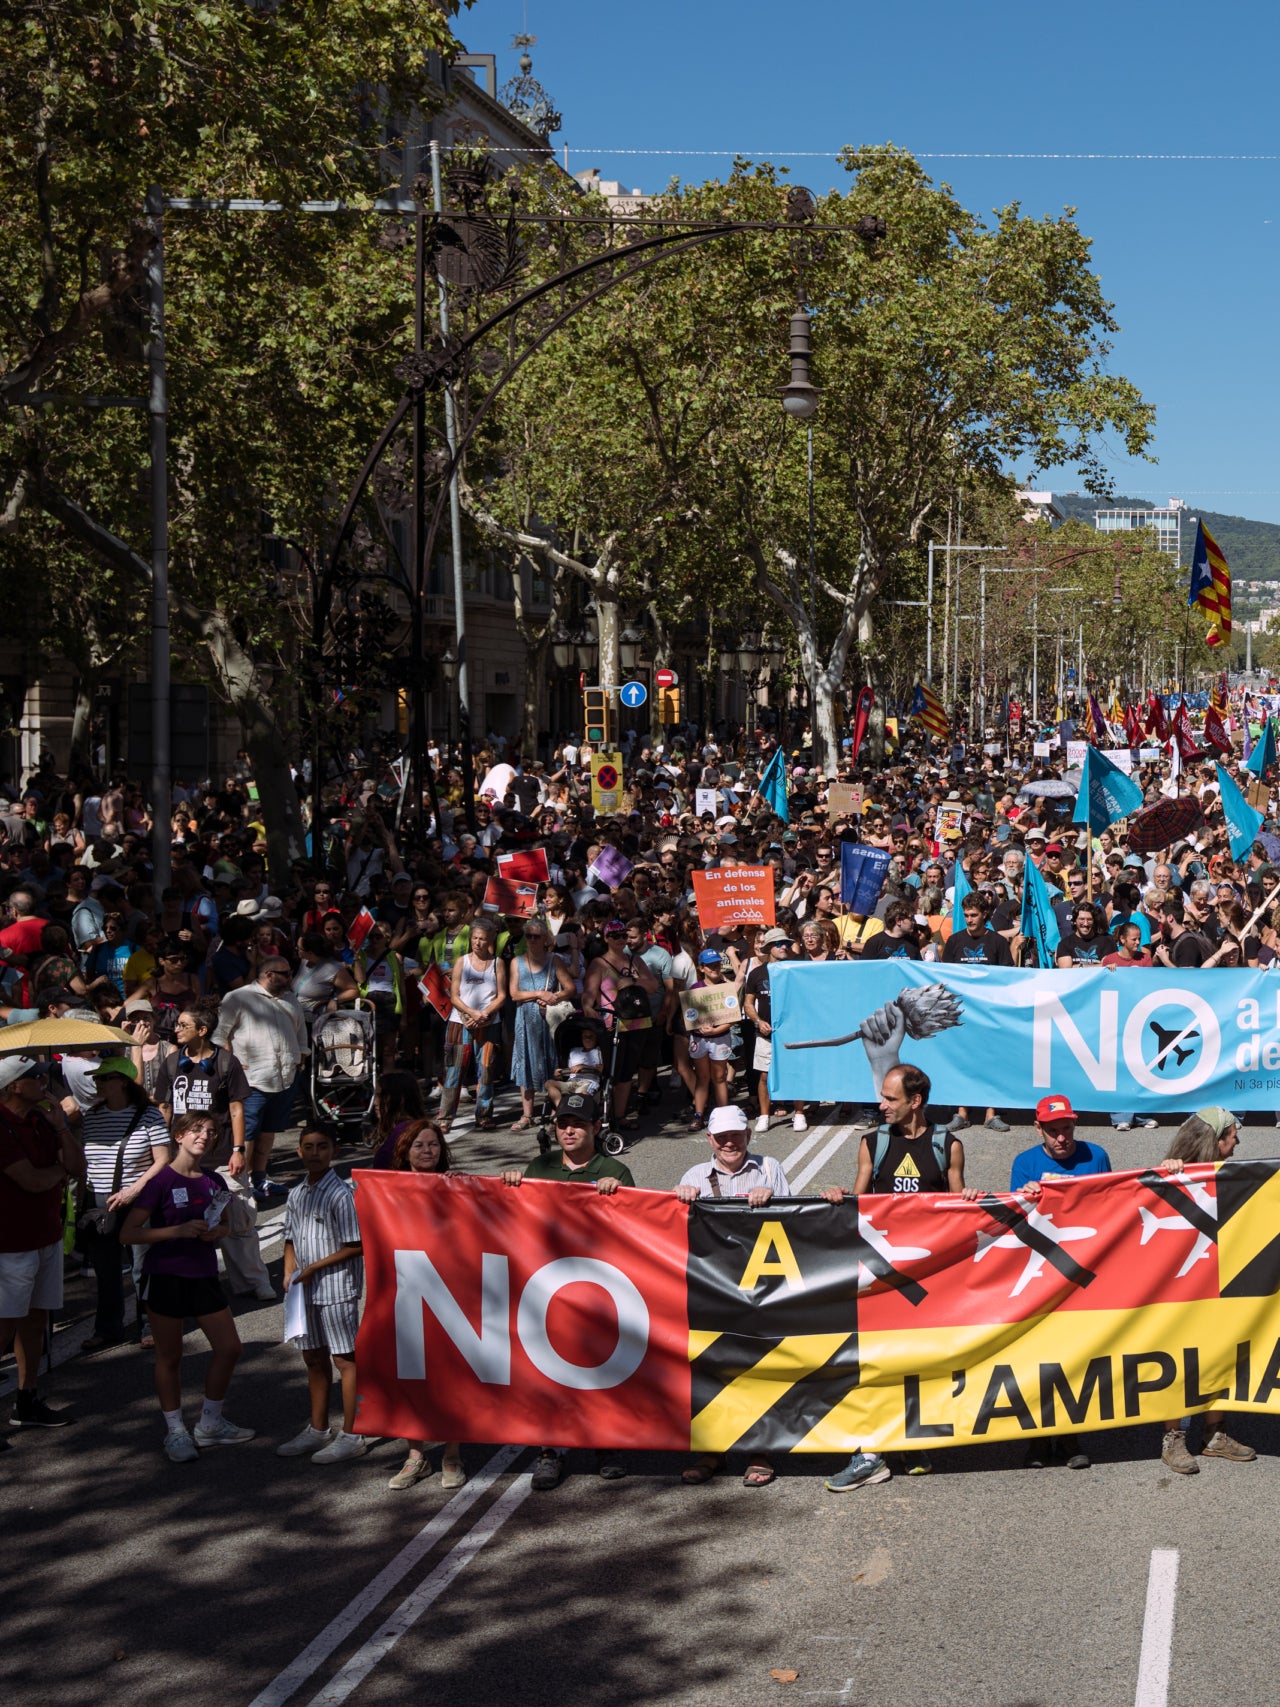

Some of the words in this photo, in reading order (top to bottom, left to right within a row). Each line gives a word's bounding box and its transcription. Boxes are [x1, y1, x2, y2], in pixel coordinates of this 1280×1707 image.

[705, 871, 721, 880] En
[725, 869, 765, 878] defensa
[723, 884, 737, 892] de
[740, 883, 756, 891] los
[717, 897, 764, 907] animales
[1033, 988, 1221, 1095] NO
[1236, 998, 1259, 1030] a
[1234, 1079, 1245, 1089] Ni
[1249, 1079, 1263, 1089] 3a
[893, 1177, 920, 1193] SOS
[738, 1221, 807, 1291] A
[394, 1249, 650, 1390] NO
